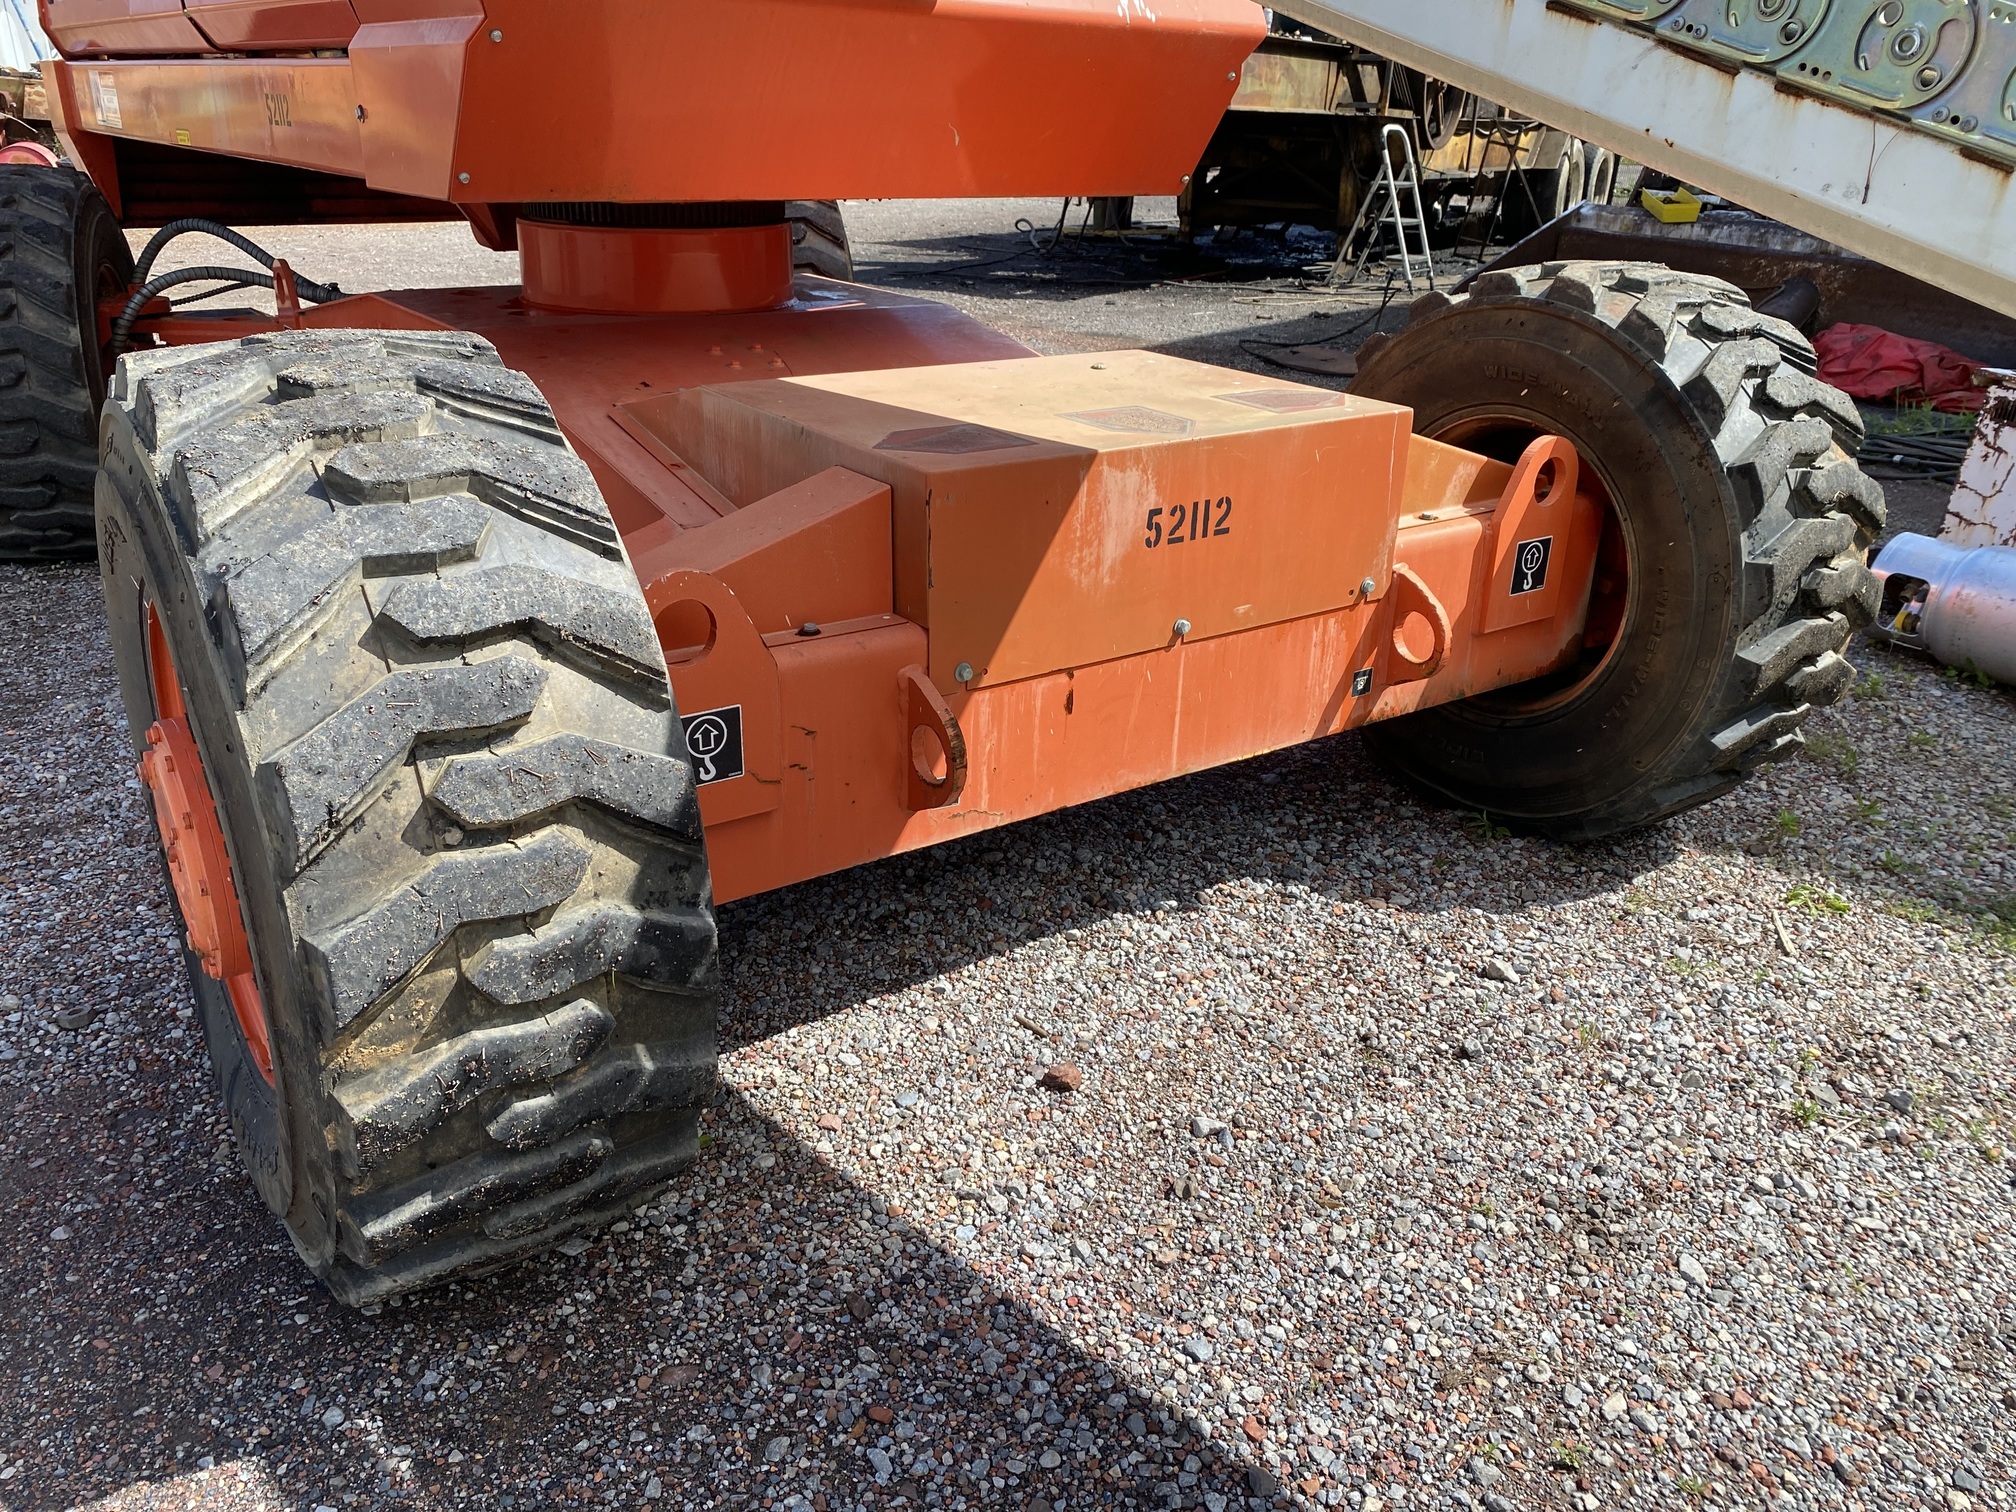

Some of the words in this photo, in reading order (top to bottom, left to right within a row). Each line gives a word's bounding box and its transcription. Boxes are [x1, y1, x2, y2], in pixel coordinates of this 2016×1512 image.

[264, 93, 292, 127] 52112
[1145, 496, 1232, 549] 52112
[1605, 586, 1669, 719] WIDE-WALL
